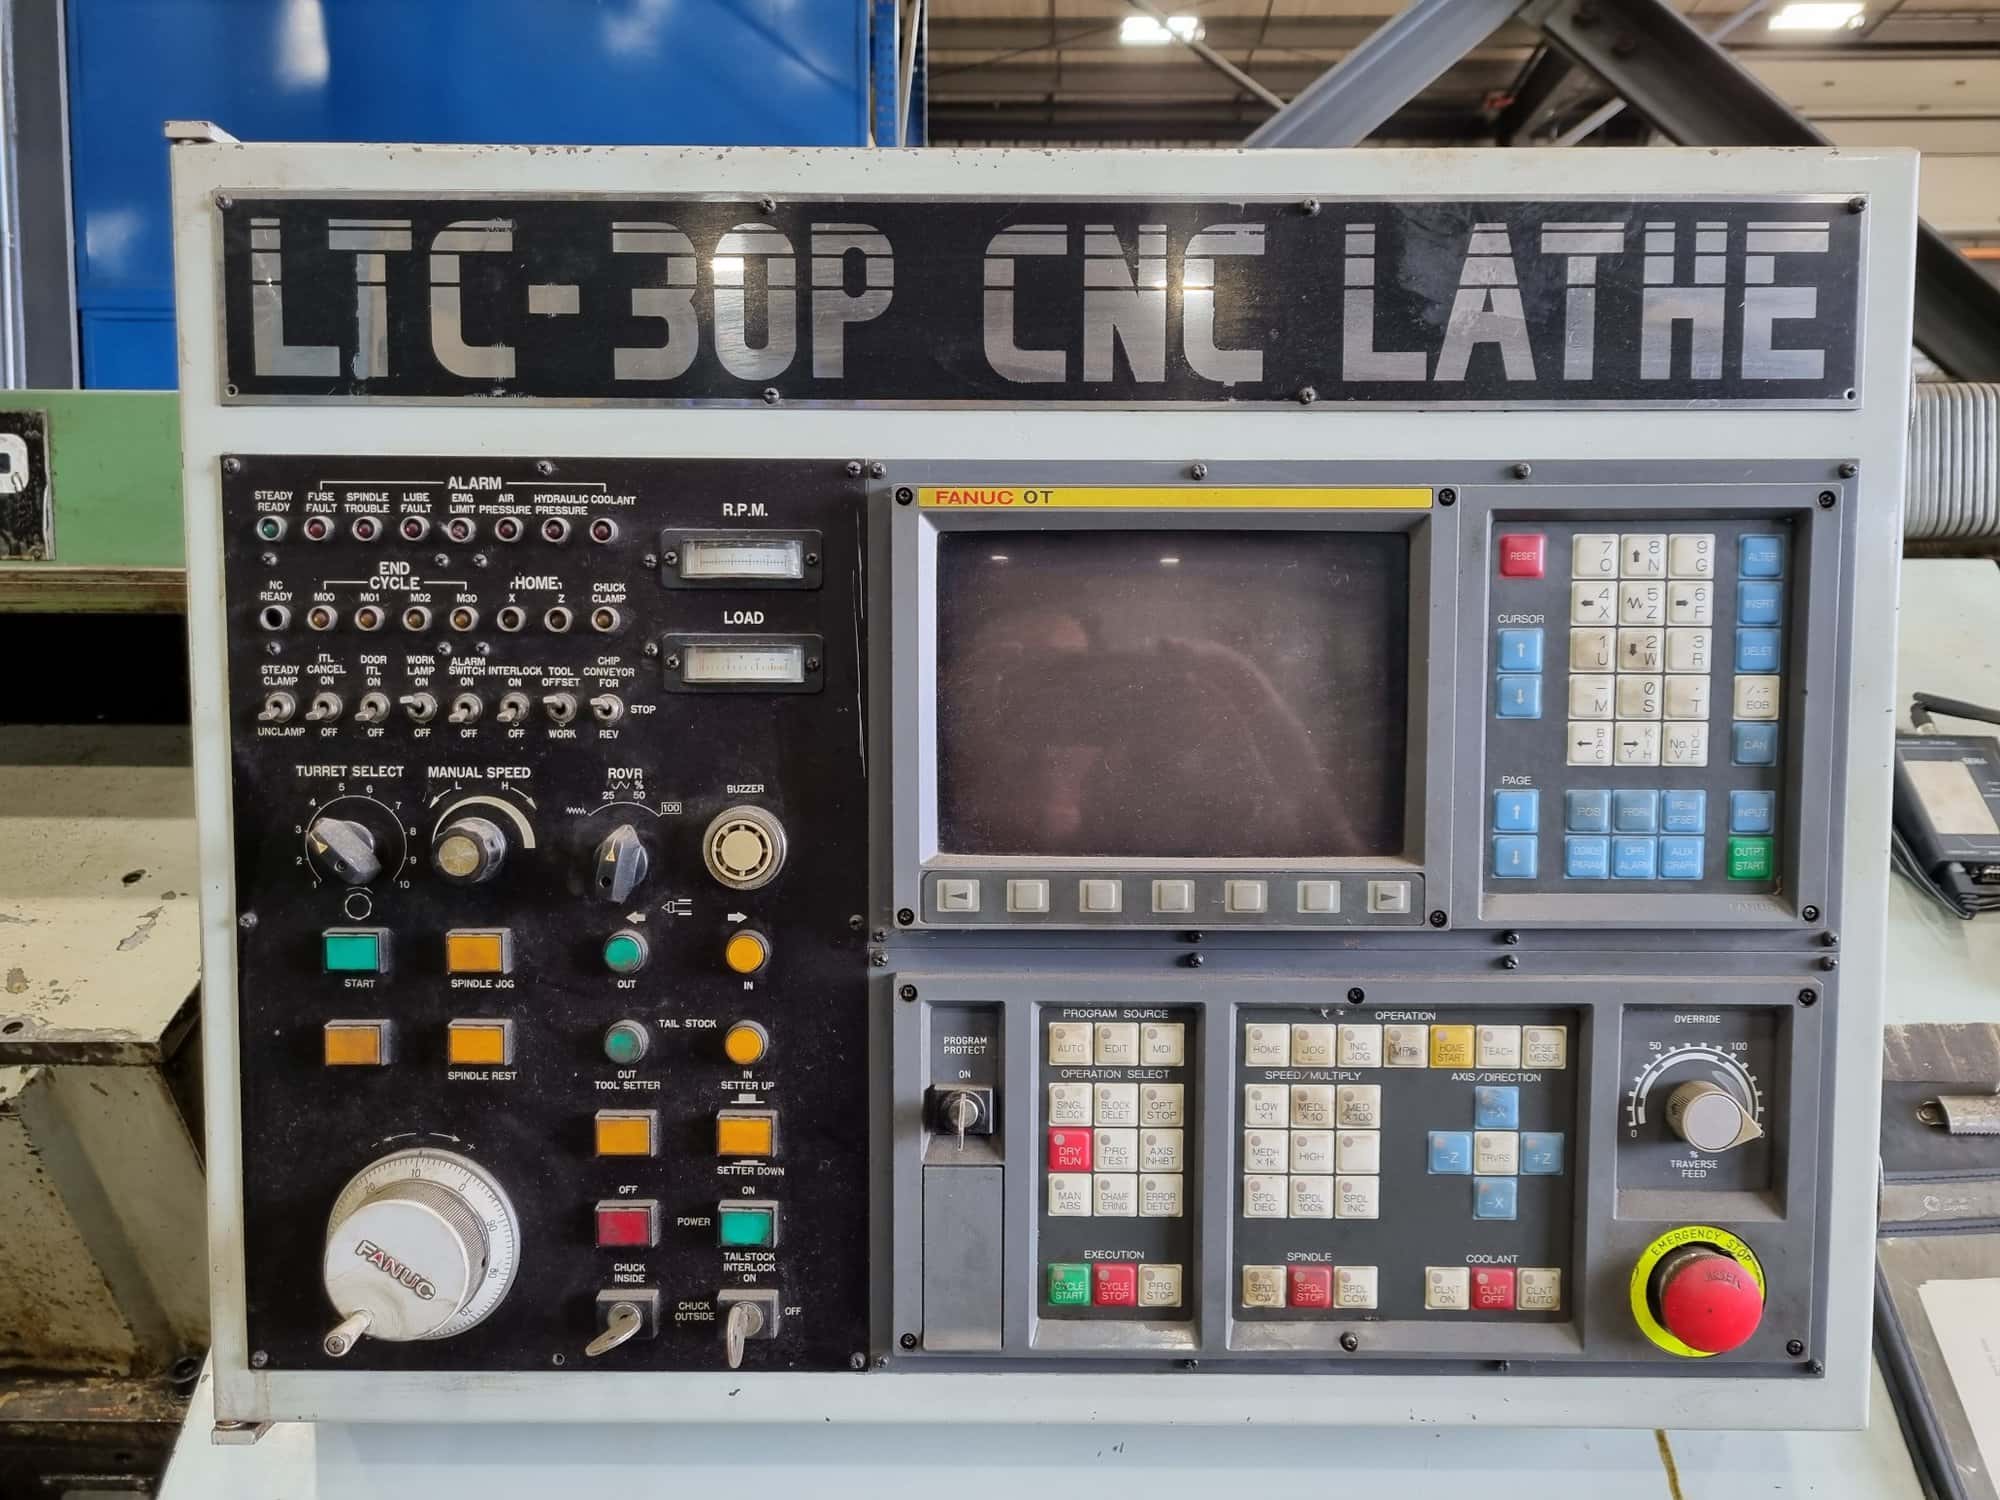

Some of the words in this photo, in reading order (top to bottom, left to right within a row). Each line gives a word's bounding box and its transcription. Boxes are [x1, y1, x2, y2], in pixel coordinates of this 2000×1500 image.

[250, 218, 893, 381] LTC-30P
[984, 224, 1265, 382] CNC
[1342, 222, 1830, 381] LATHE
[448, 477, 501, 490] ALARM
[255, 491, 293, 500] STEADY
[308, 492, 334, 502] FUSE
[347, 493, 389, 502] SPINDLE
[403, 493, 430, 502] LUBE
[452, 494, 473, 503] EMG
[498, 494, 514, 503] AIR
[534, 494, 588, 504] HYDRAULIC
[591, 495, 636, 505] COOLANT
[935, 491, 1013, 504] FANUC
[257, 503, 290, 511] READY
[306, 504, 337, 513] FAULT
[345, 504, 390, 513] TROUBLE
[401, 504, 432, 513] FAULT
[449, 505, 476, 514] LIMIT
[479, 505, 531, 515] PRESSURE
[535, 505, 587, 515] PRESSURE
[723, 503, 768, 516] R.P.M.
[1510, 552, 1536, 560] RESET
[379, 562, 410, 575] END
[269, 581, 283, 590] NC
[370, 577, 420, 590] CYCLE
[515, 577, 558, 590] HOME
[593, 583, 625, 592] CHUCK
[260, 592, 292, 601] READY
[360, 593, 379, 602] M01
[410, 594, 431, 603] M02
[509, 594, 515, 603] X
[558, 594, 565, 603] Z
[592, 594, 626, 603] CLAMP
[724, 611, 764, 624] LOAD
[1498, 614, 1544, 624] CURSOR
[319, 654, 334, 662] ITL
[360, 655, 387, 664] DOOR
[407, 655, 434, 664] WORK
[451, 657, 486, 666] ALARM
[598, 656, 620, 665] CHIP
[261, 666, 299, 674] STEADY
[307, 665, 346, 674] CANCEL
[366, 666, 381, 675] ITL
[407, 666, 435, 675] LAMP
[449, 666, 485, 675] SWITCH
[488, 667, 542, 676] INTERLOCK
[548, 667, 573, 676] TOOL
[583, 667, 634, 677] CONVEYOR
[263, 677, 298, 686] CLAMP
[320, 676, 334, 685] ON
[367, 677, 380, 686] ON
[415, 678, 428, 687] ON
[460, 678, 474, 687] ON
[508, 678, 522, 687] ON
[542, 678, 580, 687] OFFSET
[599, 679, 618, 688] FOR
[630, 705, 656, 714] STOP
[258, 727, 305, 737] UNCLAMP
[321, 728, 338, 737] OFF
[368, 728, 384, 737] OFF
[414, 728, 431, 737] OFF
[461, 728, 477, 738] OFF
[508, 729, 525, 738] OFF
[549, 729, 576, 738] WORK
[599, 729, 618, 738] REV
[296, 766, 347, 777] TURRET
[352, 766, 404, 777] SELECT
[428, 767, 482, 778] MANUAL
[487, 767, 531, 778] SPEED
[608, 768, 642, 779] ROVR
[1502, 776, 1532, 785] PAGE
[455, 782, 462, 790] L
[502, 782, 509, 790] H
[727, 785, 764, 793] BUZZER
[603, 791, 614, 800] 25
[633, 791, 645, 799] 50
[662, 804, 680, 813] 100
[1736, 862, 1764, 870] START
[345, 979, 375, 988] START
[452, 980, 493, 988] SPINDLE
[496, 980, 514, 989] JOG
[618, 980, 636, 989] OUT
[744, 981, 753, 990] IN
[1064, 1010, 1117, 1018] PROGRAM
[1124, 1010, 1168, 1018] SOURCE
[1376, 1012, 1436, 1021] OPERATION
[659, 1019, 679, 1028] TAIL
[685, 1019, 716, 1028] STOCK
[1674, 1015, 1720, 1023] OVERRIDE
[944, 1046, 985, 1054] PROTECT
[1104, 1045, 1128, 1053] EDIT
[1153, 1045, 1171, 1053] MDI
[1302, 1046, 1324, 1054] JOG
[1650, 1042, 1661, 1050] 50
[1731, 1042, 1747, 1051] 100
[1438, 1054, 1465, 1062] START
[448, 1072, 488, 1080] SPINDLE
[492, 1072, 517, 1081] REST
[618, 1071, 636, 1079] OUT
[743, 1071, 752, 1079] IN
[959, 1070, 971, 1078] ON
[1061, 1070, 1121, 1078] OPERATION
[1128, 1070, 1169, 1078] SELECT
[595, 1081, 619, 1090] TOOL
[623, 1081, 660, 1090] SETTER
[721, 1081, 758, 1090] SETTER
[761, 1081, 774, 1090] UP
[1151, 1102, 1173, 1110] OPT
[1059, 1147, 1081, 1155] DRY
[1150, 1147, 1173, 1155] AXIS
[1059, 1157, 1081, 1165] RUN
[1671, 1160, 1718, 1169] TRAVERSE
[717, 1167, 754, 1175] SETTER
[757, 1167, 784, 1176] DOWN
[1682, 1169, 1706, 1178] FEED
[619, 1186, 638, 1194] OFF
[742, 1186, 755, 1195] ON
[677, 1218, 710, 1226] POWER
[1651, 1229, 1721, 1256] EMERGENCY
[1726, 1239, 1752, 1262] STOP
[724, 1253, 775, 1261] TAILSTOCK
[1084, 1251, 1144, 1259] EXECUTION
[1288, 1253, 1332, 1261] SPINDLE
[1466, 1255, 1518, 1263] COOLANT
[355, 1240, 437, 1301] FANUC
[614, 1264, 645, 1272] CHUCK
[723, 1264, 776, 1272] INTERLOCK
[614, 1274, 645, 1282] INSIDE
[743, 1274, 756, 1282] ON
[1055, 1282, 1083, 1290] CYCLE
[1100, 1282, 1128, 1290] CYCLE
[678, 1302, 709, 1310] CHUCK
[785, 1307, 801, 1315] OFF
[675, 1312, 714, 1320] OUTSIDE
